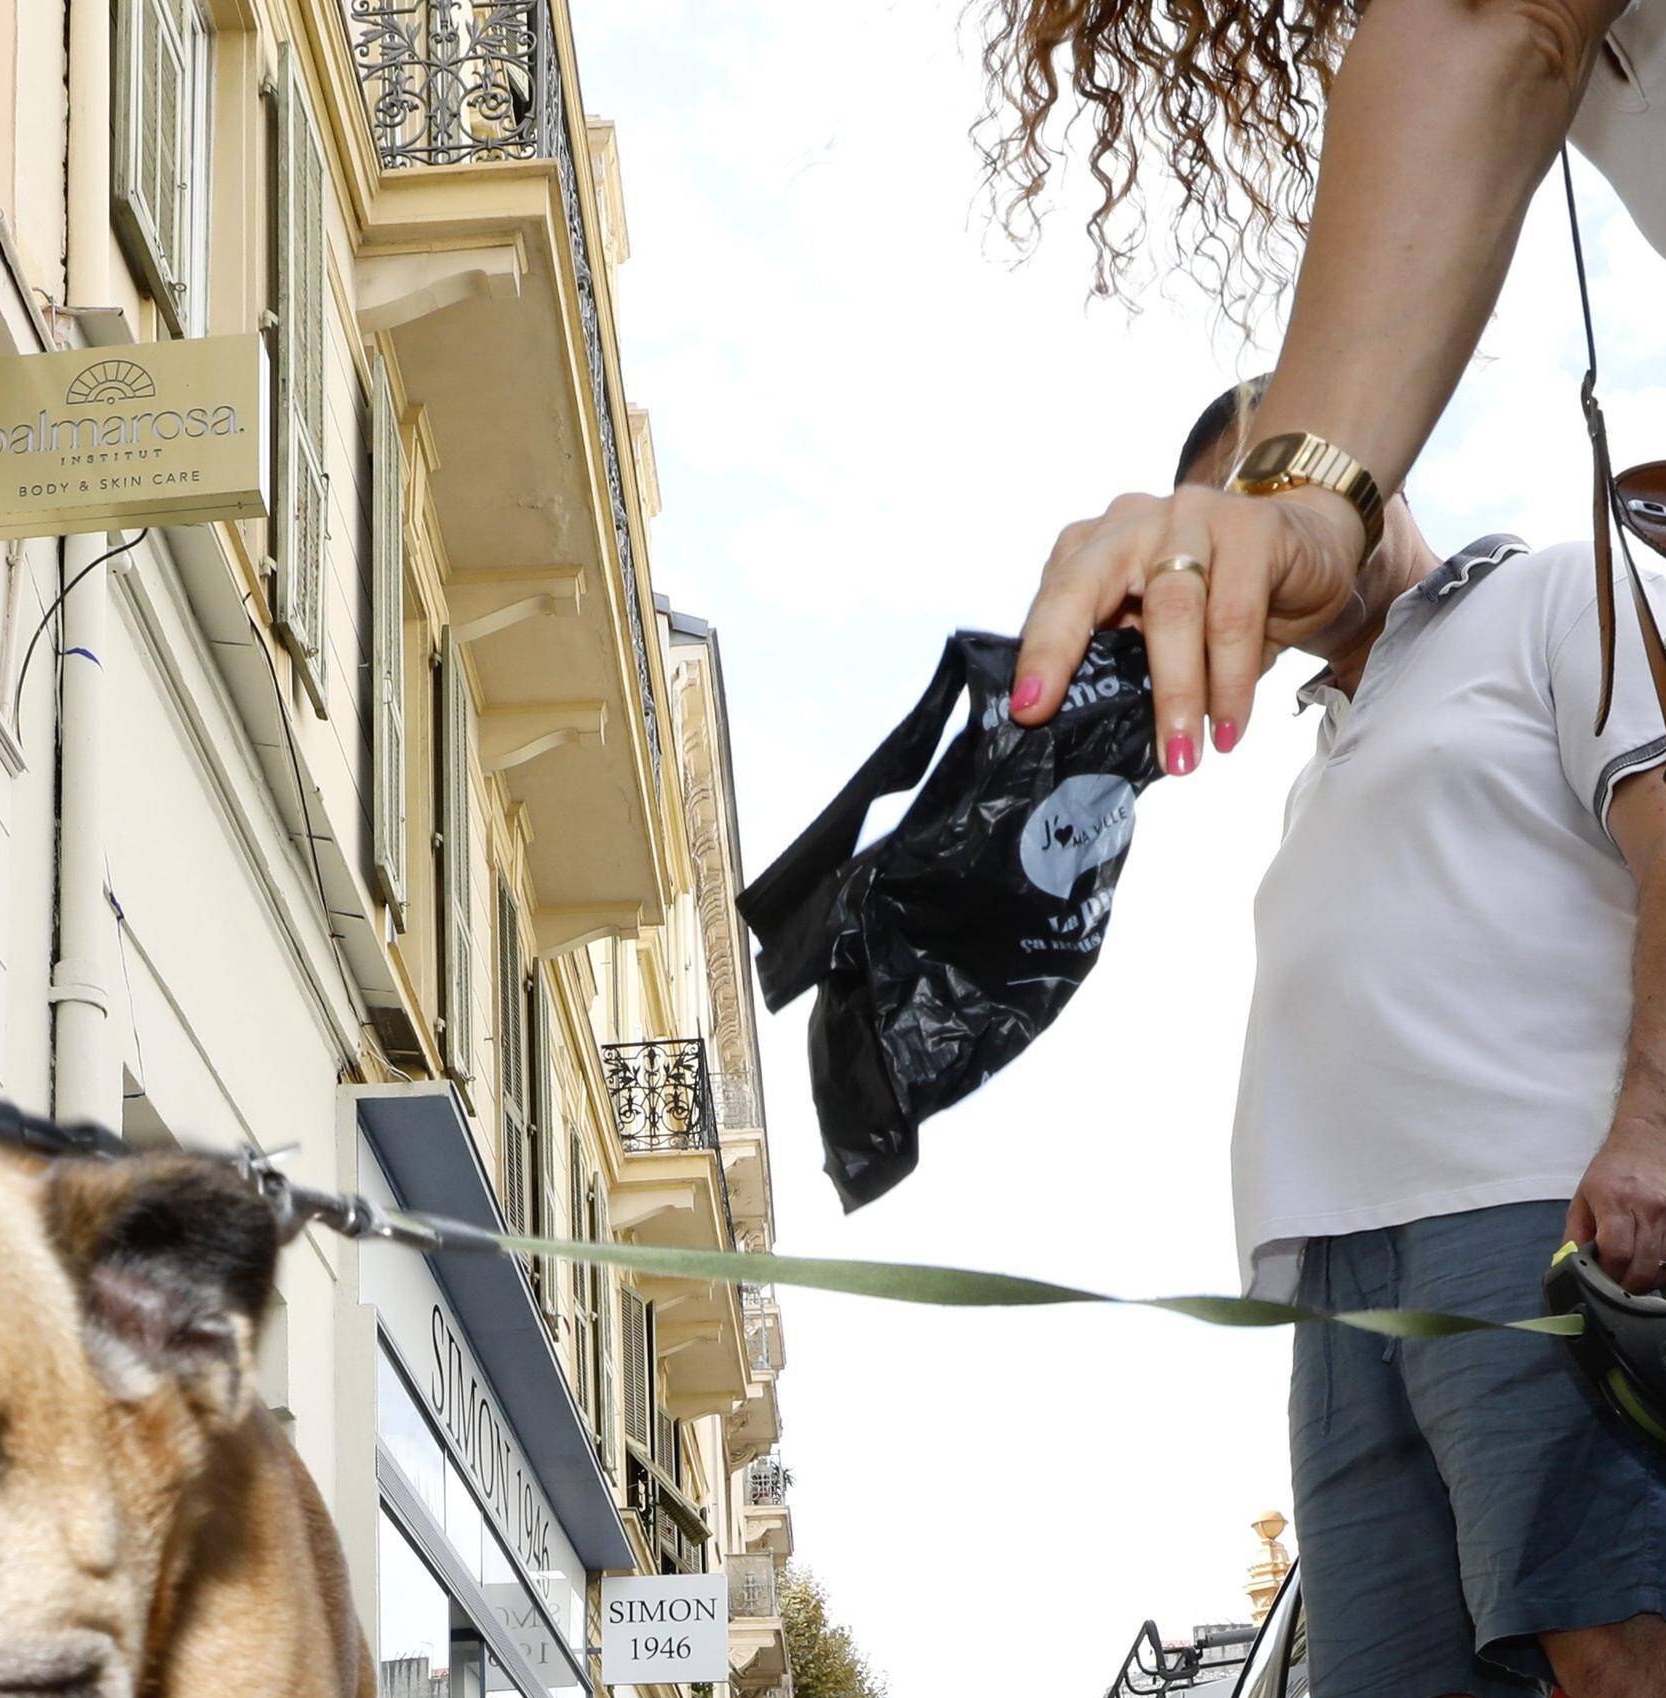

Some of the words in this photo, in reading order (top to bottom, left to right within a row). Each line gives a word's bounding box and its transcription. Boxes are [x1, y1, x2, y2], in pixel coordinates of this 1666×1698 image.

[59, 448, 164, 466] INSTITUT
[18, 481, 70, 498] BODY
[78, 480, 90, 492] &
[99, 475, 143, 491] SKIN
[152, 470, 202, 485] CARE
[431, 1304, 511, 1532] SIMON
[516, 1468, 551, 1600] 1946
[608, 1597, 718, 1624] SIMON
[630, 1635, 692, 1661] 1946
